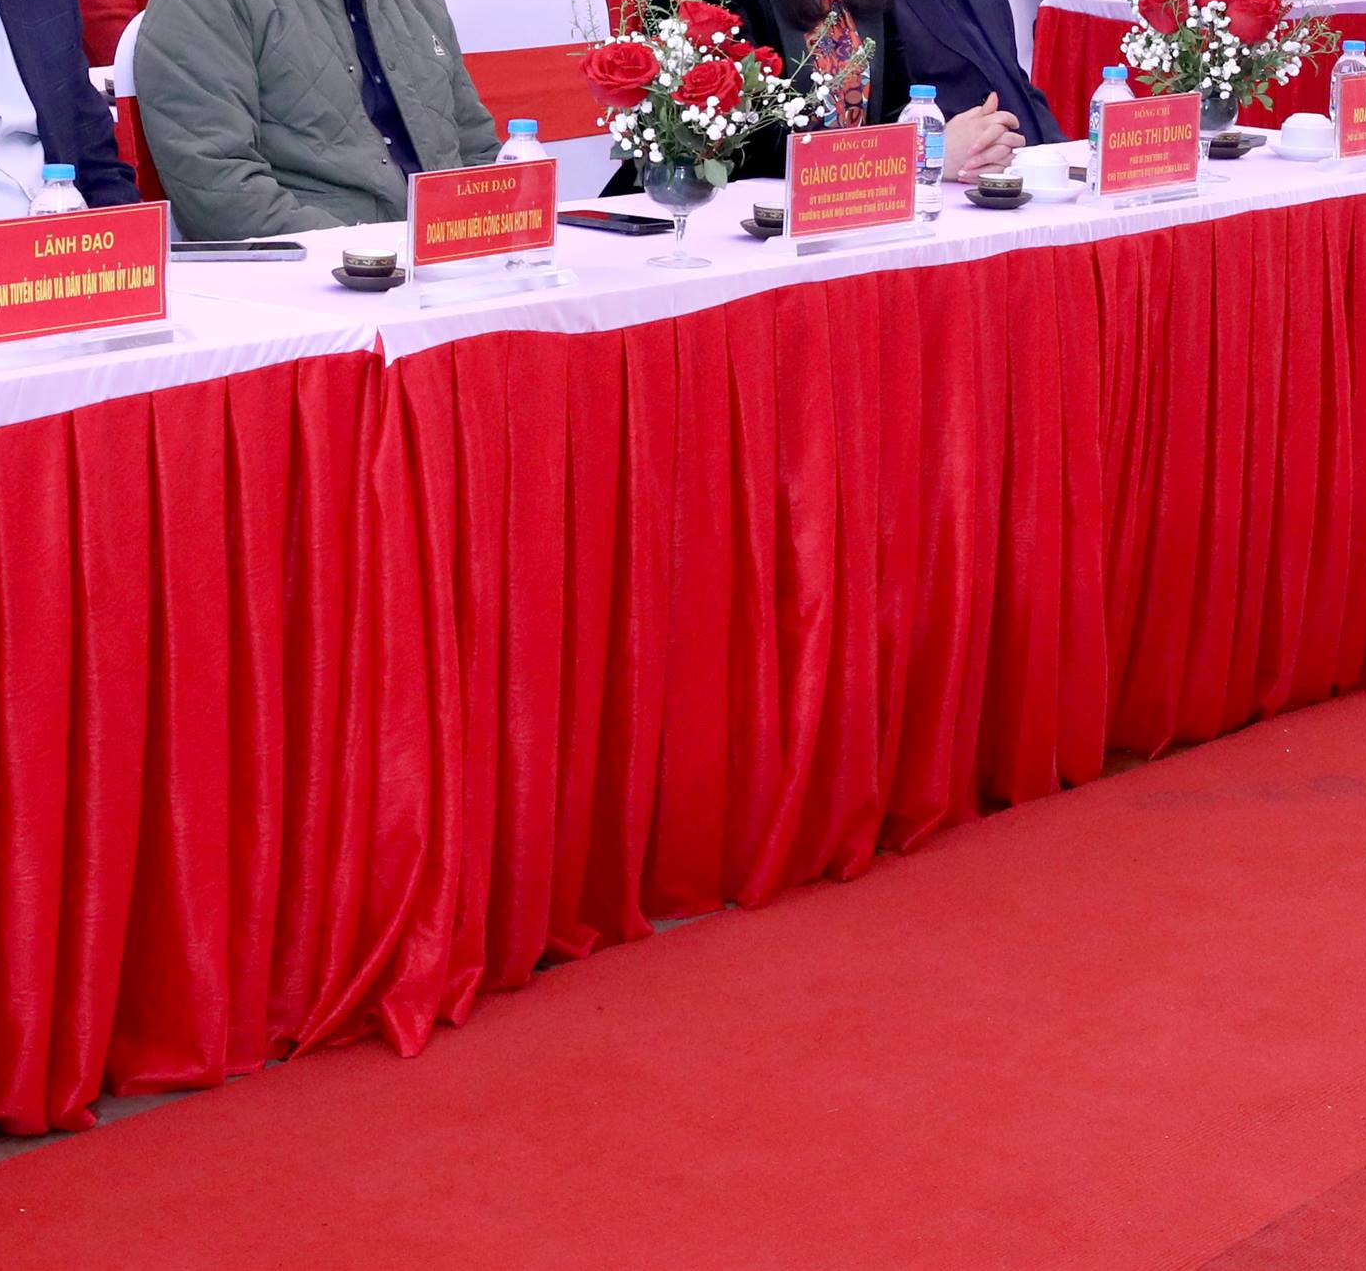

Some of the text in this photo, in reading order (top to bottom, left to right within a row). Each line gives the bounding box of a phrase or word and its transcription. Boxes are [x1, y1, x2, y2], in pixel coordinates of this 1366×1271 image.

[861, 137, 878, 150] CHÍ
[1108, 124, 1192, 150] GIÀNG THỊ DUNG
[800, 154, 907, 186] GIÀNG QUỐC HƯNG
[457, 178, 516, 196] LÃNH ĐẠO
[35, 231, 114, 258] LÃNH ĐẠO
[10, 277, 33, 305] TUYÊN
[35, 274, 52, 302] GIÁO
[53, 272, 64, 299] VÀ
[65, 270, 80, 298] DÂN
[82, 269, 98, 300] VẬN
[99, 264, 115, 295] TỈNH
[116, 262, 127, 292] ỦY
[128, 262, 142, 290] LÀO
[142, 265, 155, 287] CAI
